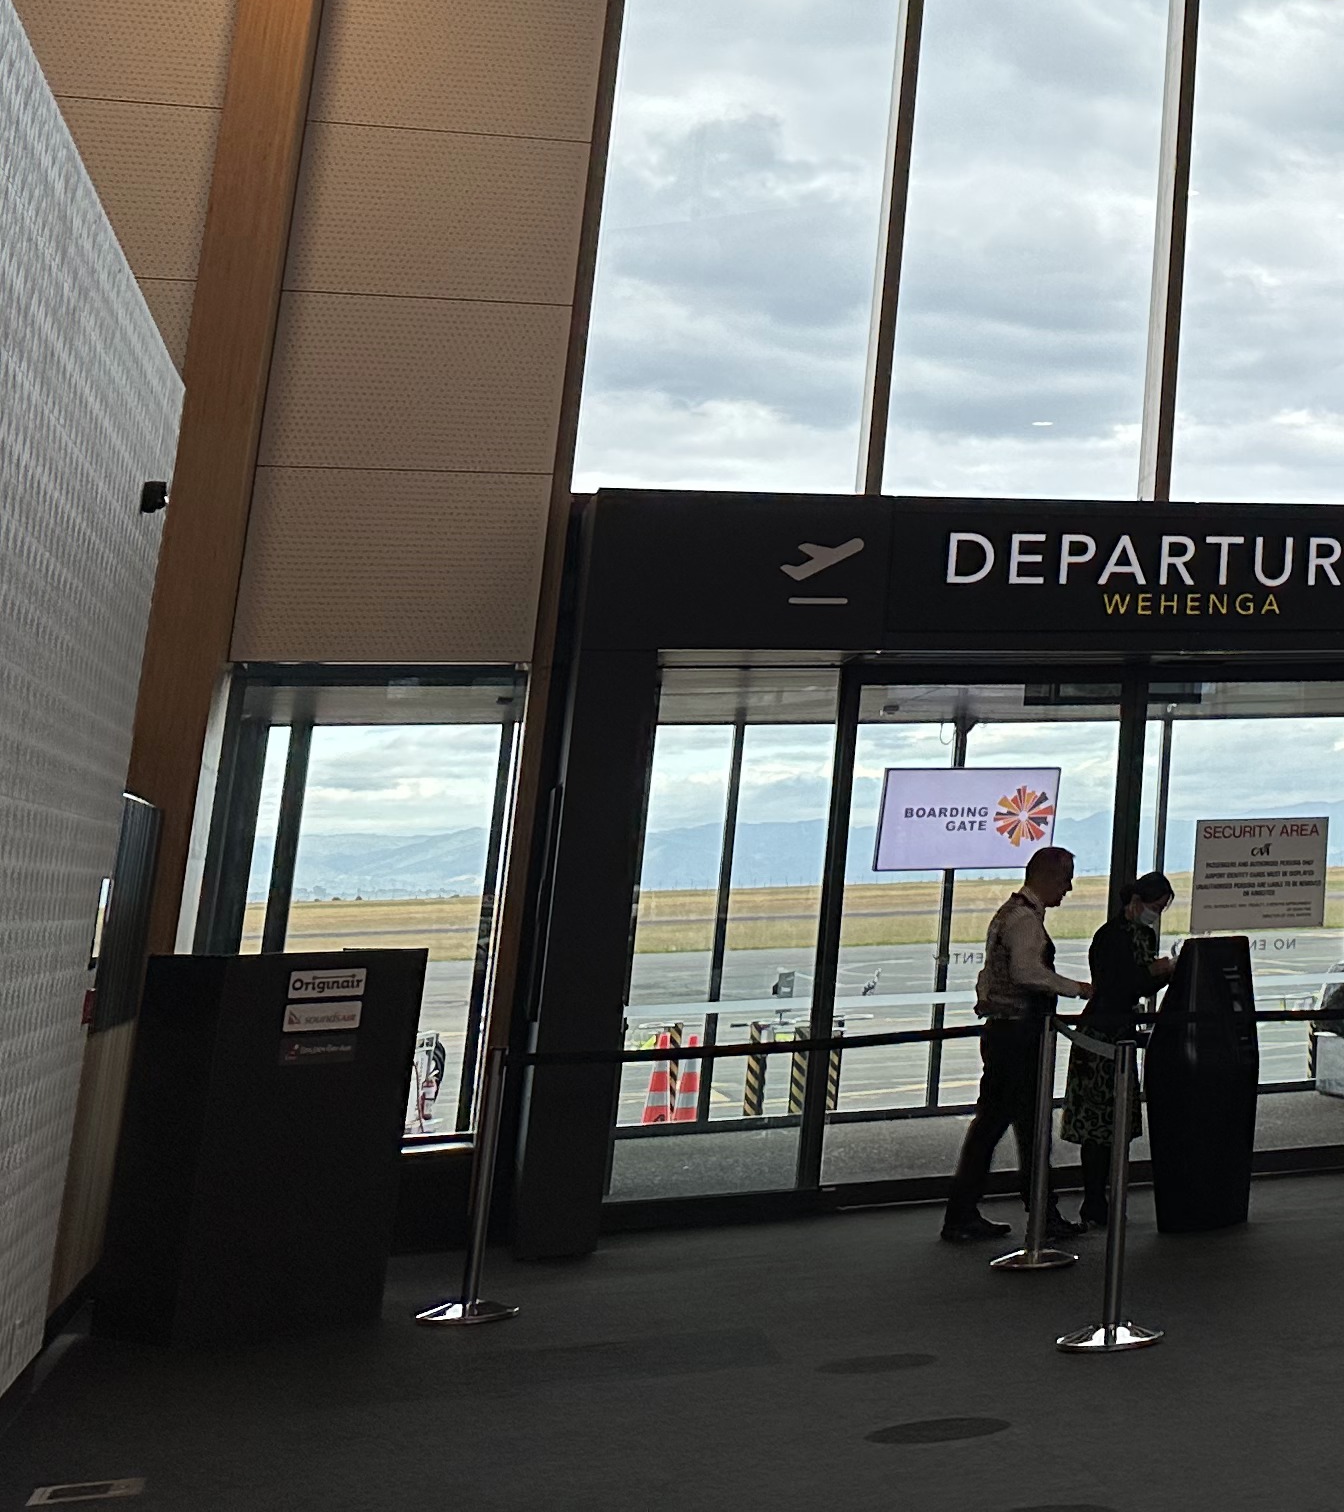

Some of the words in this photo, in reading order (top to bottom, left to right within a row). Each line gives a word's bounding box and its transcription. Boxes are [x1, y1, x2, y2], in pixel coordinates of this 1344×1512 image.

[1104, 594, 1280, 615] WEHENGA
[904, 807, 989, 819] BOARDING
[945, 821, 987, 831] GATE
[1203, 824, 1276, 839] SECURITY
[1280, 824, 1320, 837] AREA
[292, 978, 363, 993] Originair
